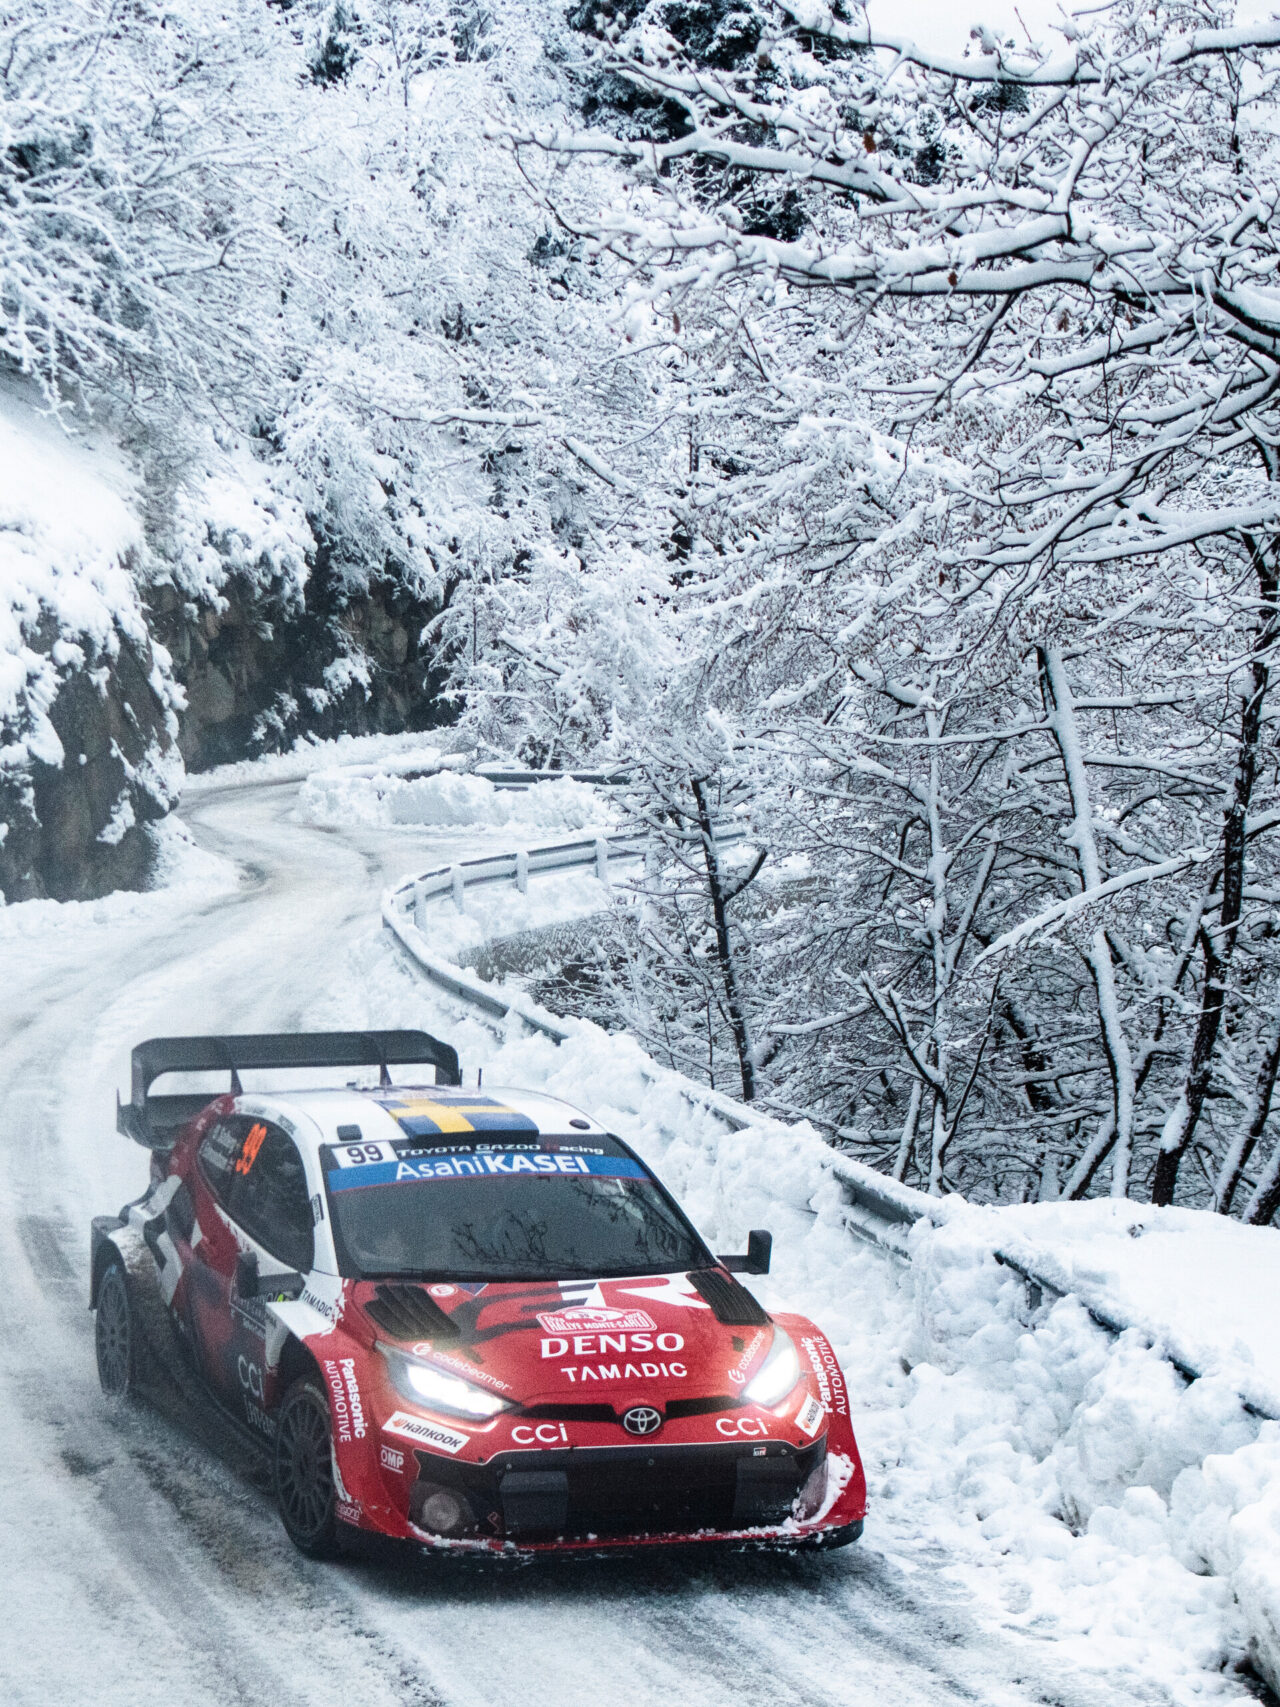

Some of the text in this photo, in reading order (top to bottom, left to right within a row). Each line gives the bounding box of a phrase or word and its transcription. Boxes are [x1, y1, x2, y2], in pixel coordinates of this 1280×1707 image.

[346, 1145, 384, 1164] 99
[397, 1145, 471, 1157] TOYOTA
[476, 1144, 541, 1154] GAZOO
[396, 1153, 590, 1180] AsahiKASEI
[302, 1290, 333, 1317] TAMADIC
[548, 1318, 582, 1331] RALLYE
[540, 1333, 685, 1358] DENSO
[433, 1351, 509, 1390] codebeamer
[561, 1362, 688, 1382] TAMADIC
[801, 1337, 833, 1414] Panasonic
[813, 1335, 847, 1416] AUTOMOTIVE
[324, 1359, 352, 1443] AUTOMOTIVE
[339, 1358, 368, 1439] Panasonic
[380, 1449, 405, 1469] OMP
